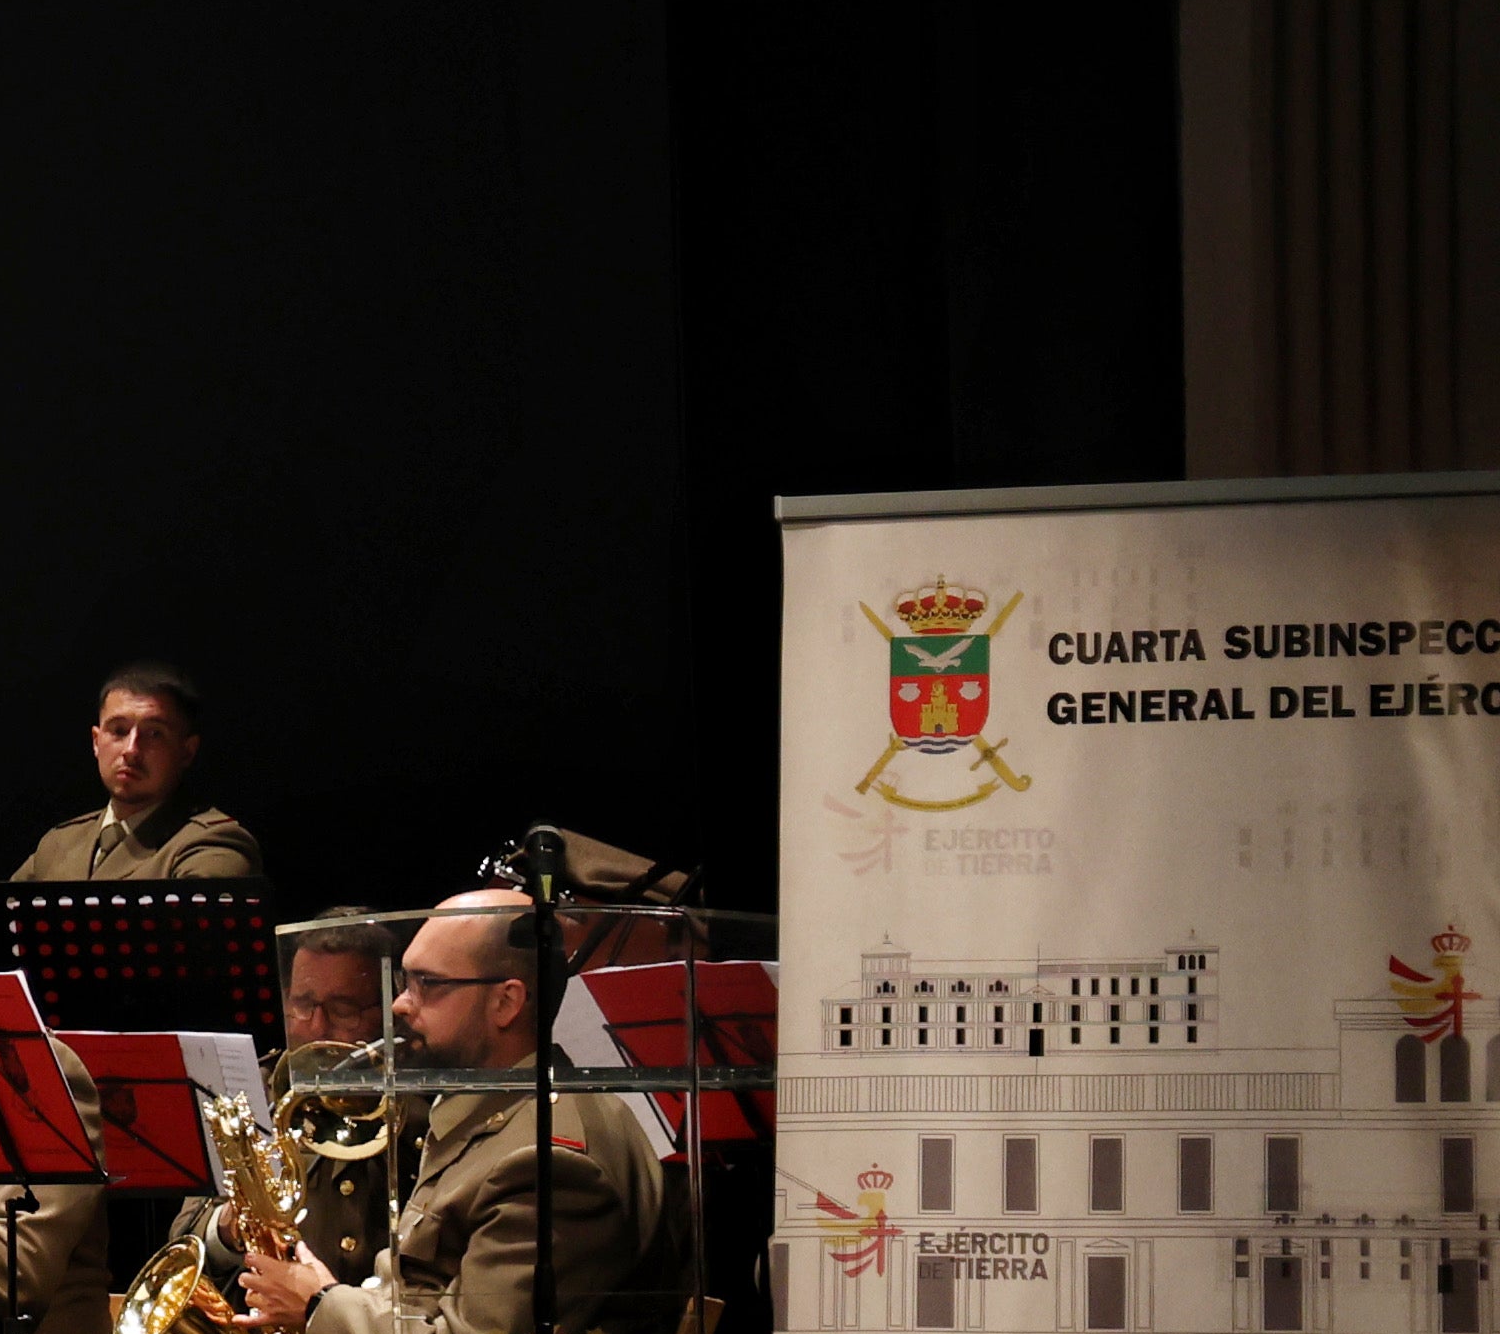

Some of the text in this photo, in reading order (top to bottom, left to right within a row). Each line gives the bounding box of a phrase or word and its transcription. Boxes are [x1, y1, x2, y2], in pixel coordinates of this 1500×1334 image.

[1048, 619, 1500, 665] CUARTA SUBINSPECC
[1046, 687, 1255, 725] GENERAL
[1269, 685, 1356, 720] DEL
[919, 1226, 1050, 1255] EJÉRCITO
[919, 1257, 1049, 1280] DE TIERRA
